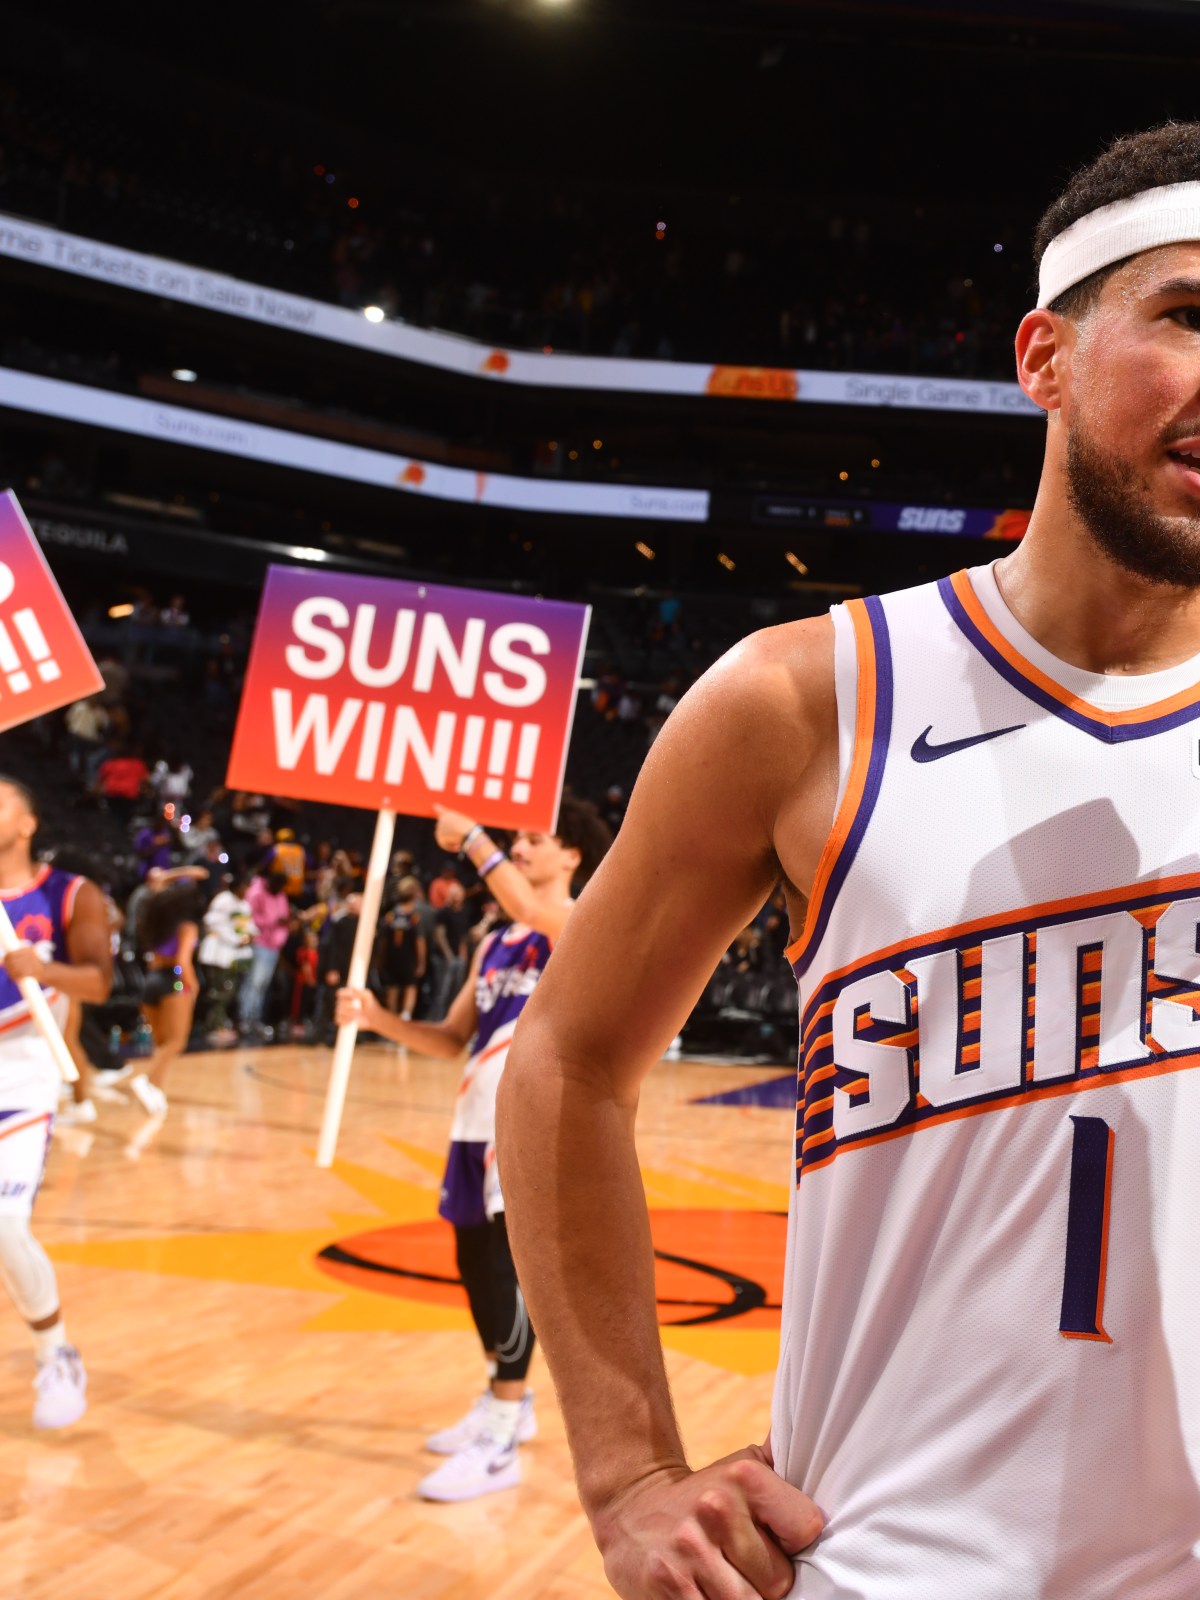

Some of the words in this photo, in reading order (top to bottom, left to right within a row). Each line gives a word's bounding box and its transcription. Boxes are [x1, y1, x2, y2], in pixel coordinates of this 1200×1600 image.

[54, 238, 149, 282] Tickets
[153, 268, 192, 294] on
[845, 377, 911, 403] Single
[916, 381, 982, 406] Game
[285, 596, 551, 708] SUNS
[272, 687, 541, 804] WIN!!!
[1058, 1114, 1116, 1344] 1
